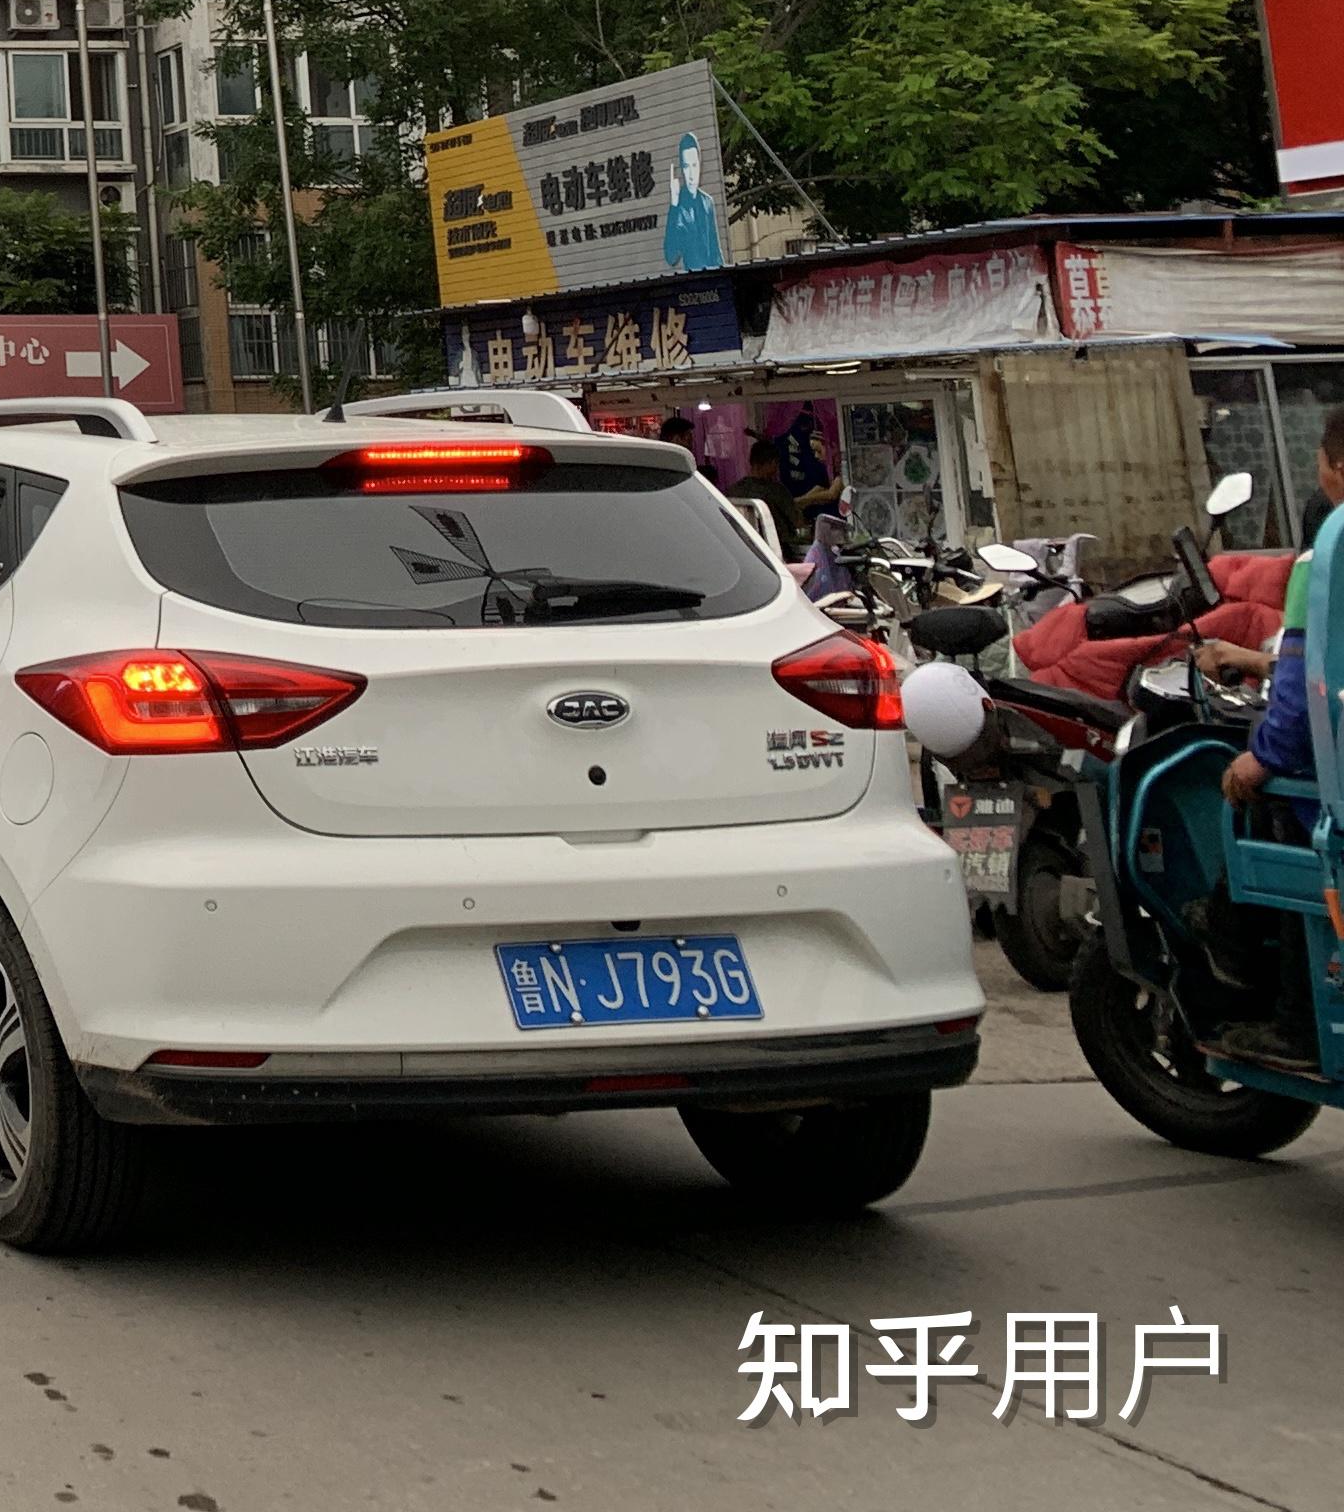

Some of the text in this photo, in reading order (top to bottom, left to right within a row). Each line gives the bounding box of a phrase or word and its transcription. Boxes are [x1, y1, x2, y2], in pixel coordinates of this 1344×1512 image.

[487, 306, 696, 382] 电动车维修
[561, 699, 620, 718] JAC
[293, 745, 379, 767] 江淮汽车
